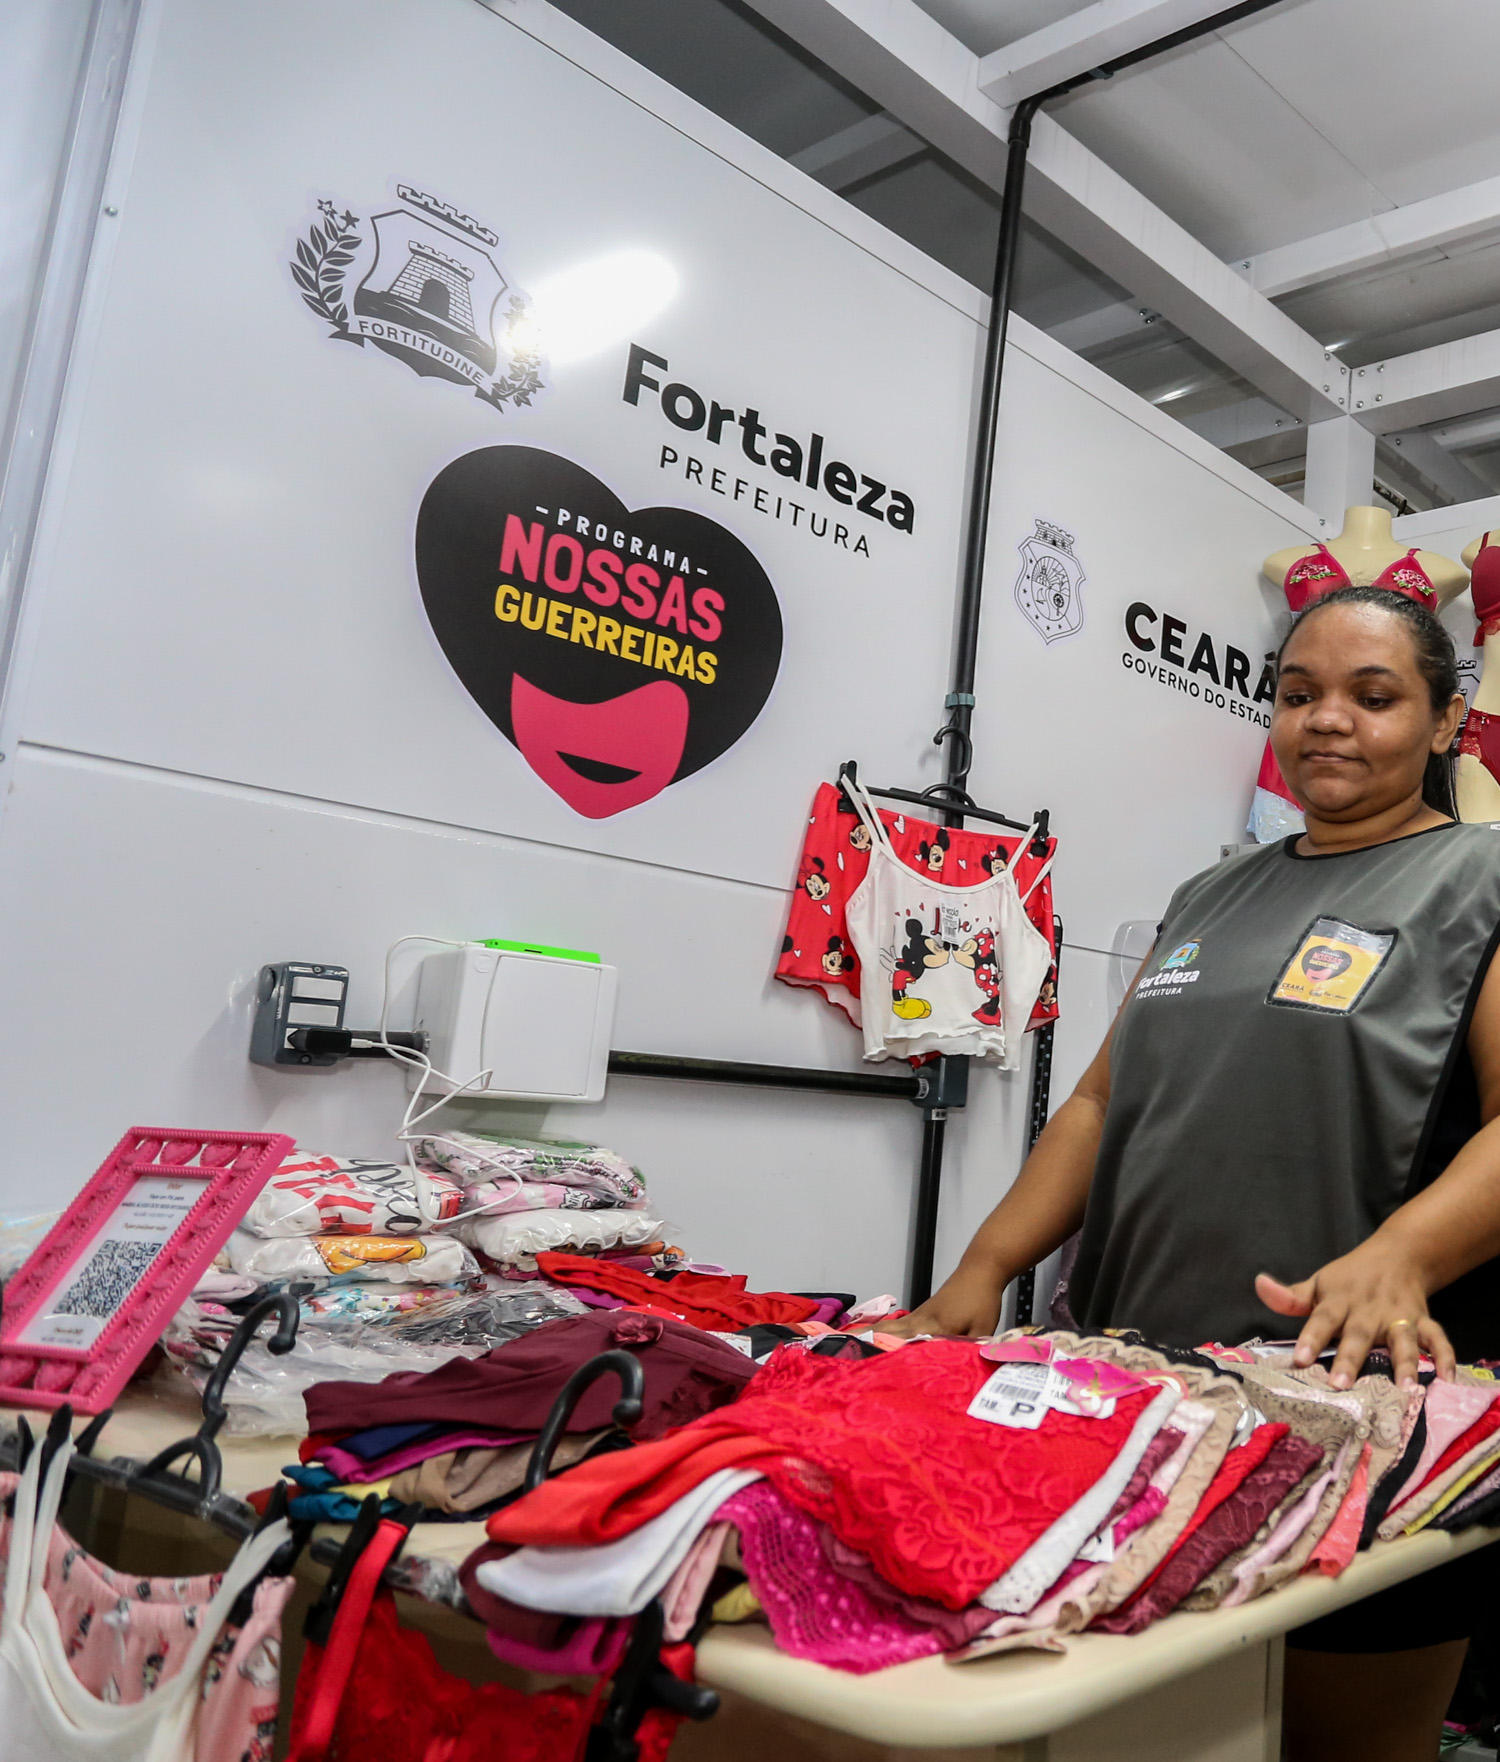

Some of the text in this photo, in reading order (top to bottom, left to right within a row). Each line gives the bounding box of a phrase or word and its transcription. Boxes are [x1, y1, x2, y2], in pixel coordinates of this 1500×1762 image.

[358, 319, 485, 385] FORTITUDINE
[621, 343, 914, 535] Fortaleza
[659, 446, 871, 558] PREFEITURA
[499, 513, 726, 642] NOSSAS
[494, 583, 719, 685] GUERREIRAS
[1121, 652, 1272, 729] GOVERNO DO ESTAD
[1135, 968, 1201, 994] Fortaleza
[1135, 987, 1183, 1001] PREFEITURA
[1010, 1402, 1035, 1416] P
